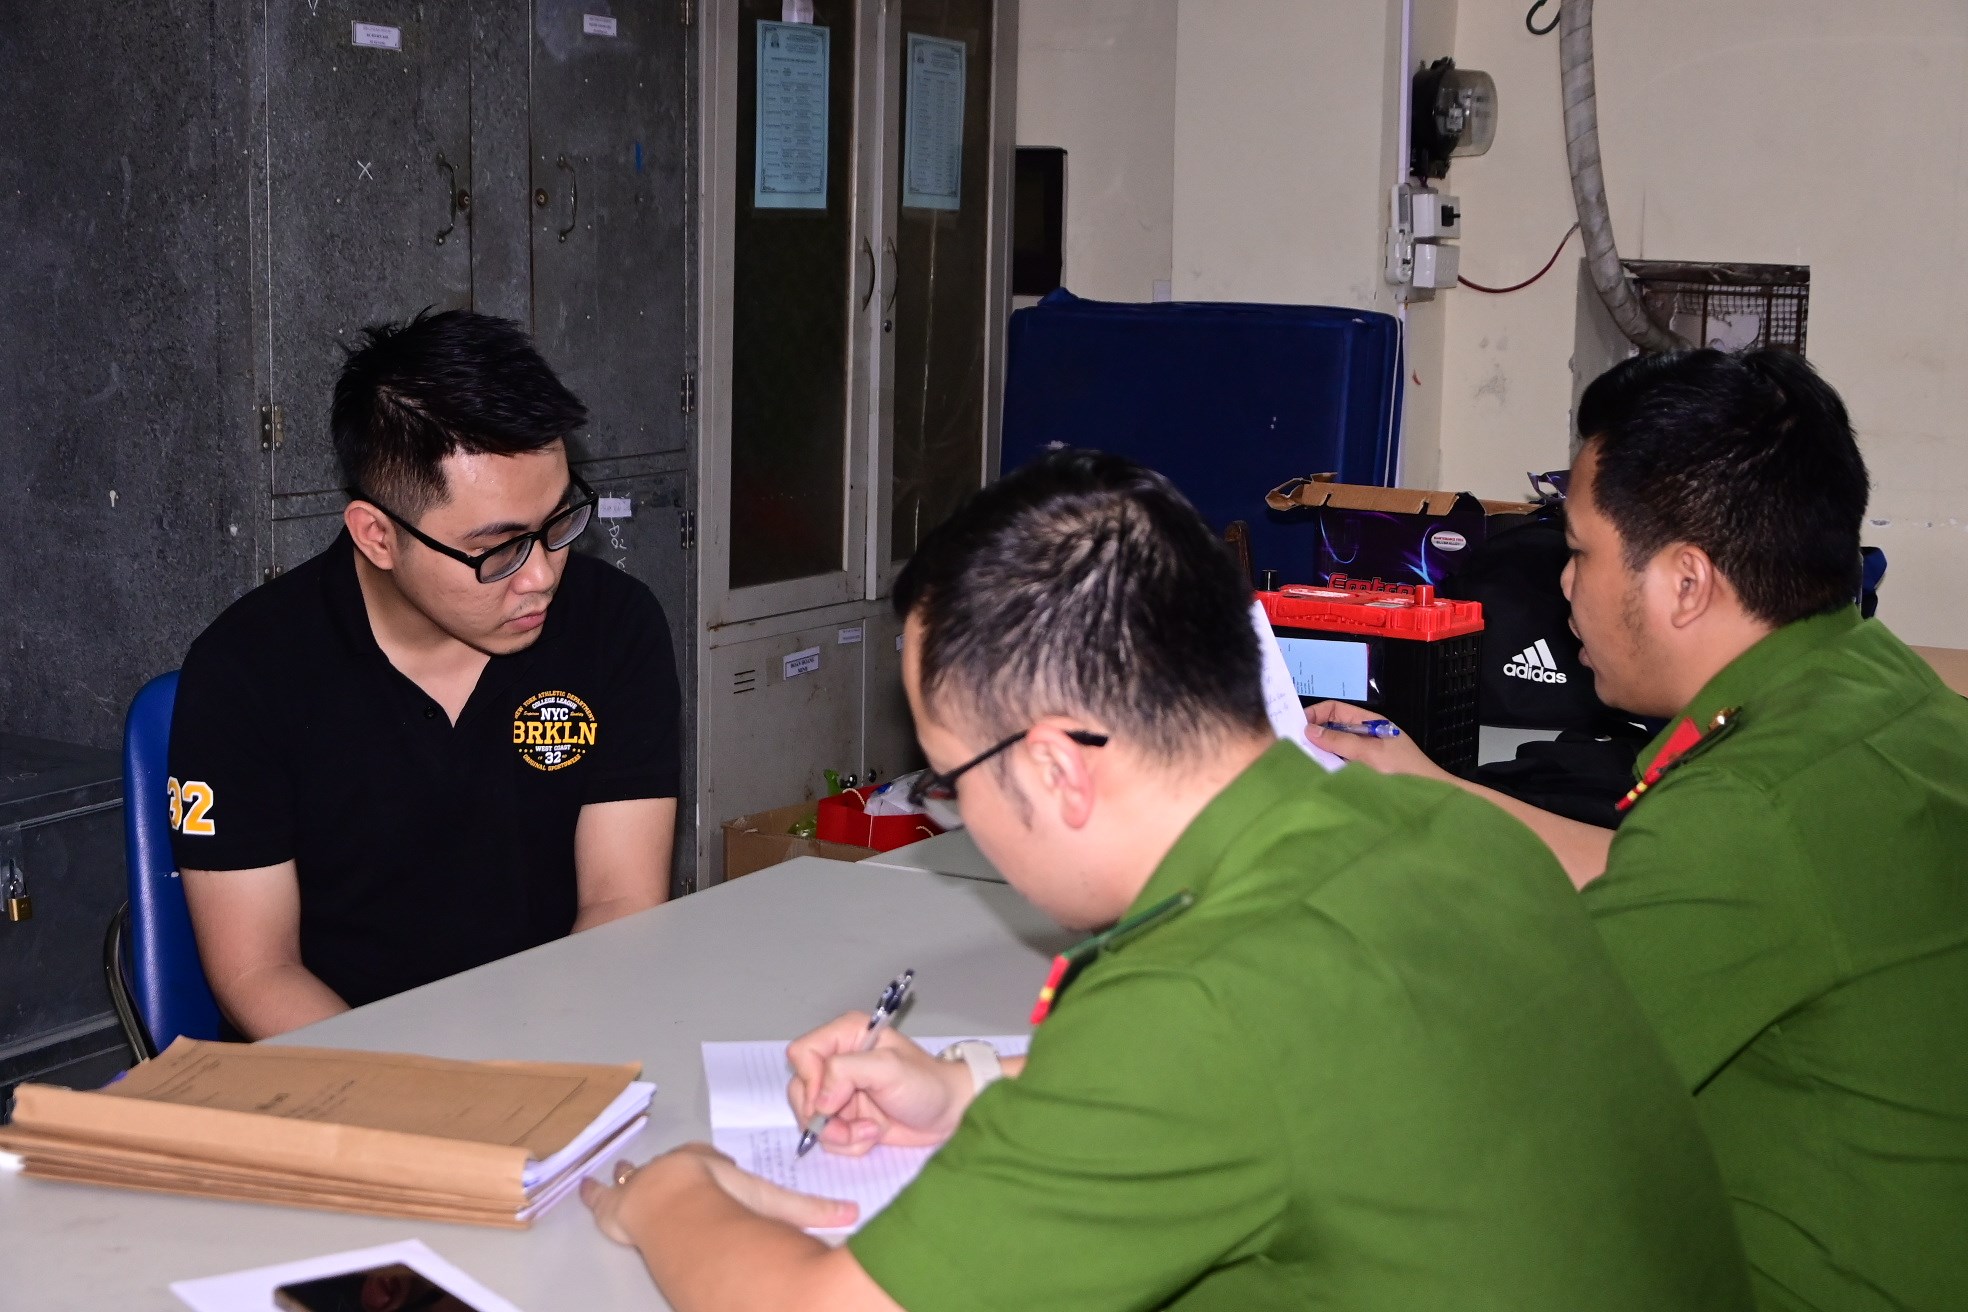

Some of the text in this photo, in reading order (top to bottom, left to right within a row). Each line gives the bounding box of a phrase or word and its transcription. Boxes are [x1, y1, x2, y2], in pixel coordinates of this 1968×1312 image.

[1503, 663, 1567, 684] adidas
[523, 695, 537, 707] YORK
[538, 690, 566, 699] ATHLETIC
[566, 692, 595, 721] DEPARTMENT
[531, 697, 577, 709] COLLEGE LEAGUE
[540, 707, 569, 721] NYC
[513, 720, 598, 745] BRKLN
[522, 753, 547, 771] ORIGINAL
[544, 751, 562, 764] 32
[167, 776, 216, 836] 32
